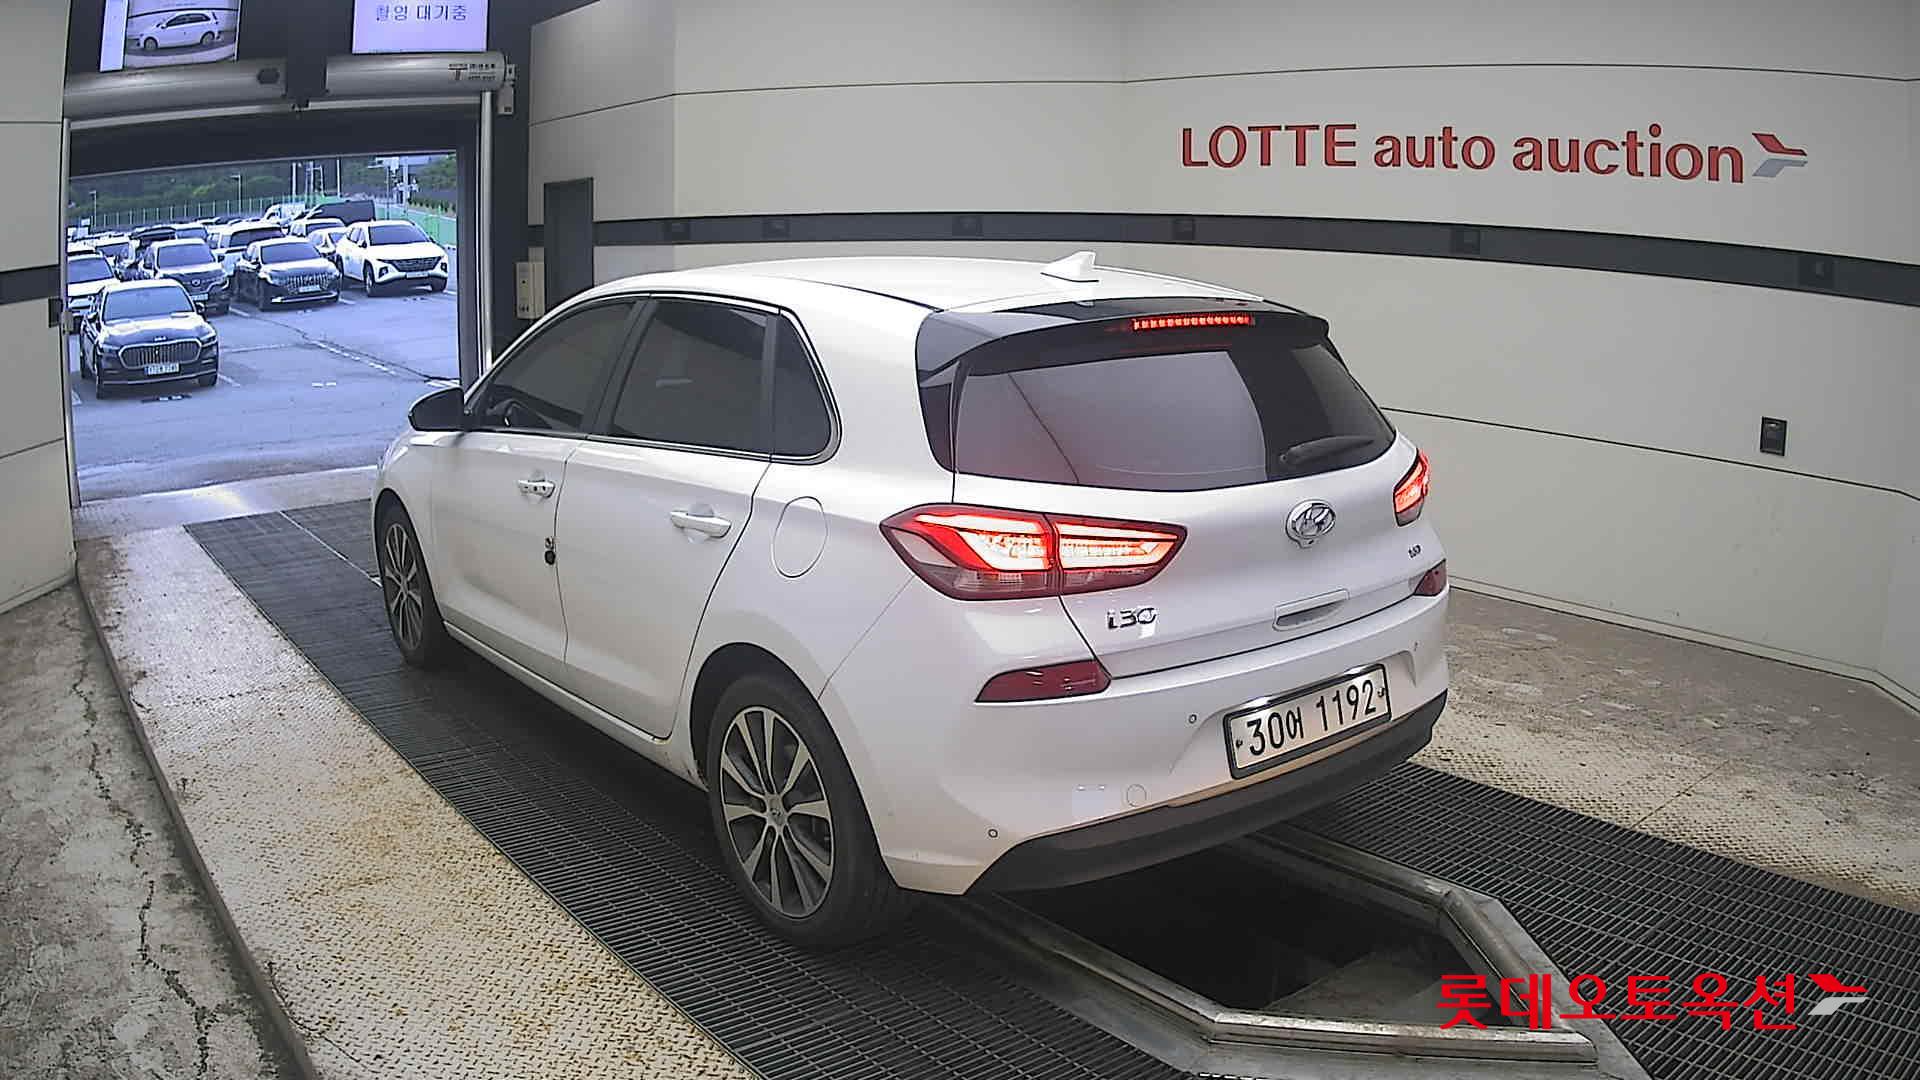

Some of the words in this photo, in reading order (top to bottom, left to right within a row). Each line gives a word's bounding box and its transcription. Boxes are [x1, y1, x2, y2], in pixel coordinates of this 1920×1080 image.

[416, 4, 467, 21] 대기중
[1182, 124, 1358, 168] LOTTE
[1374, 126, 1496, 170] auto
[1512, 123, 1745, 184] auction
[1246, 706, 1305, 756] 30어
[1315, 679, 1377, 732] 1192
